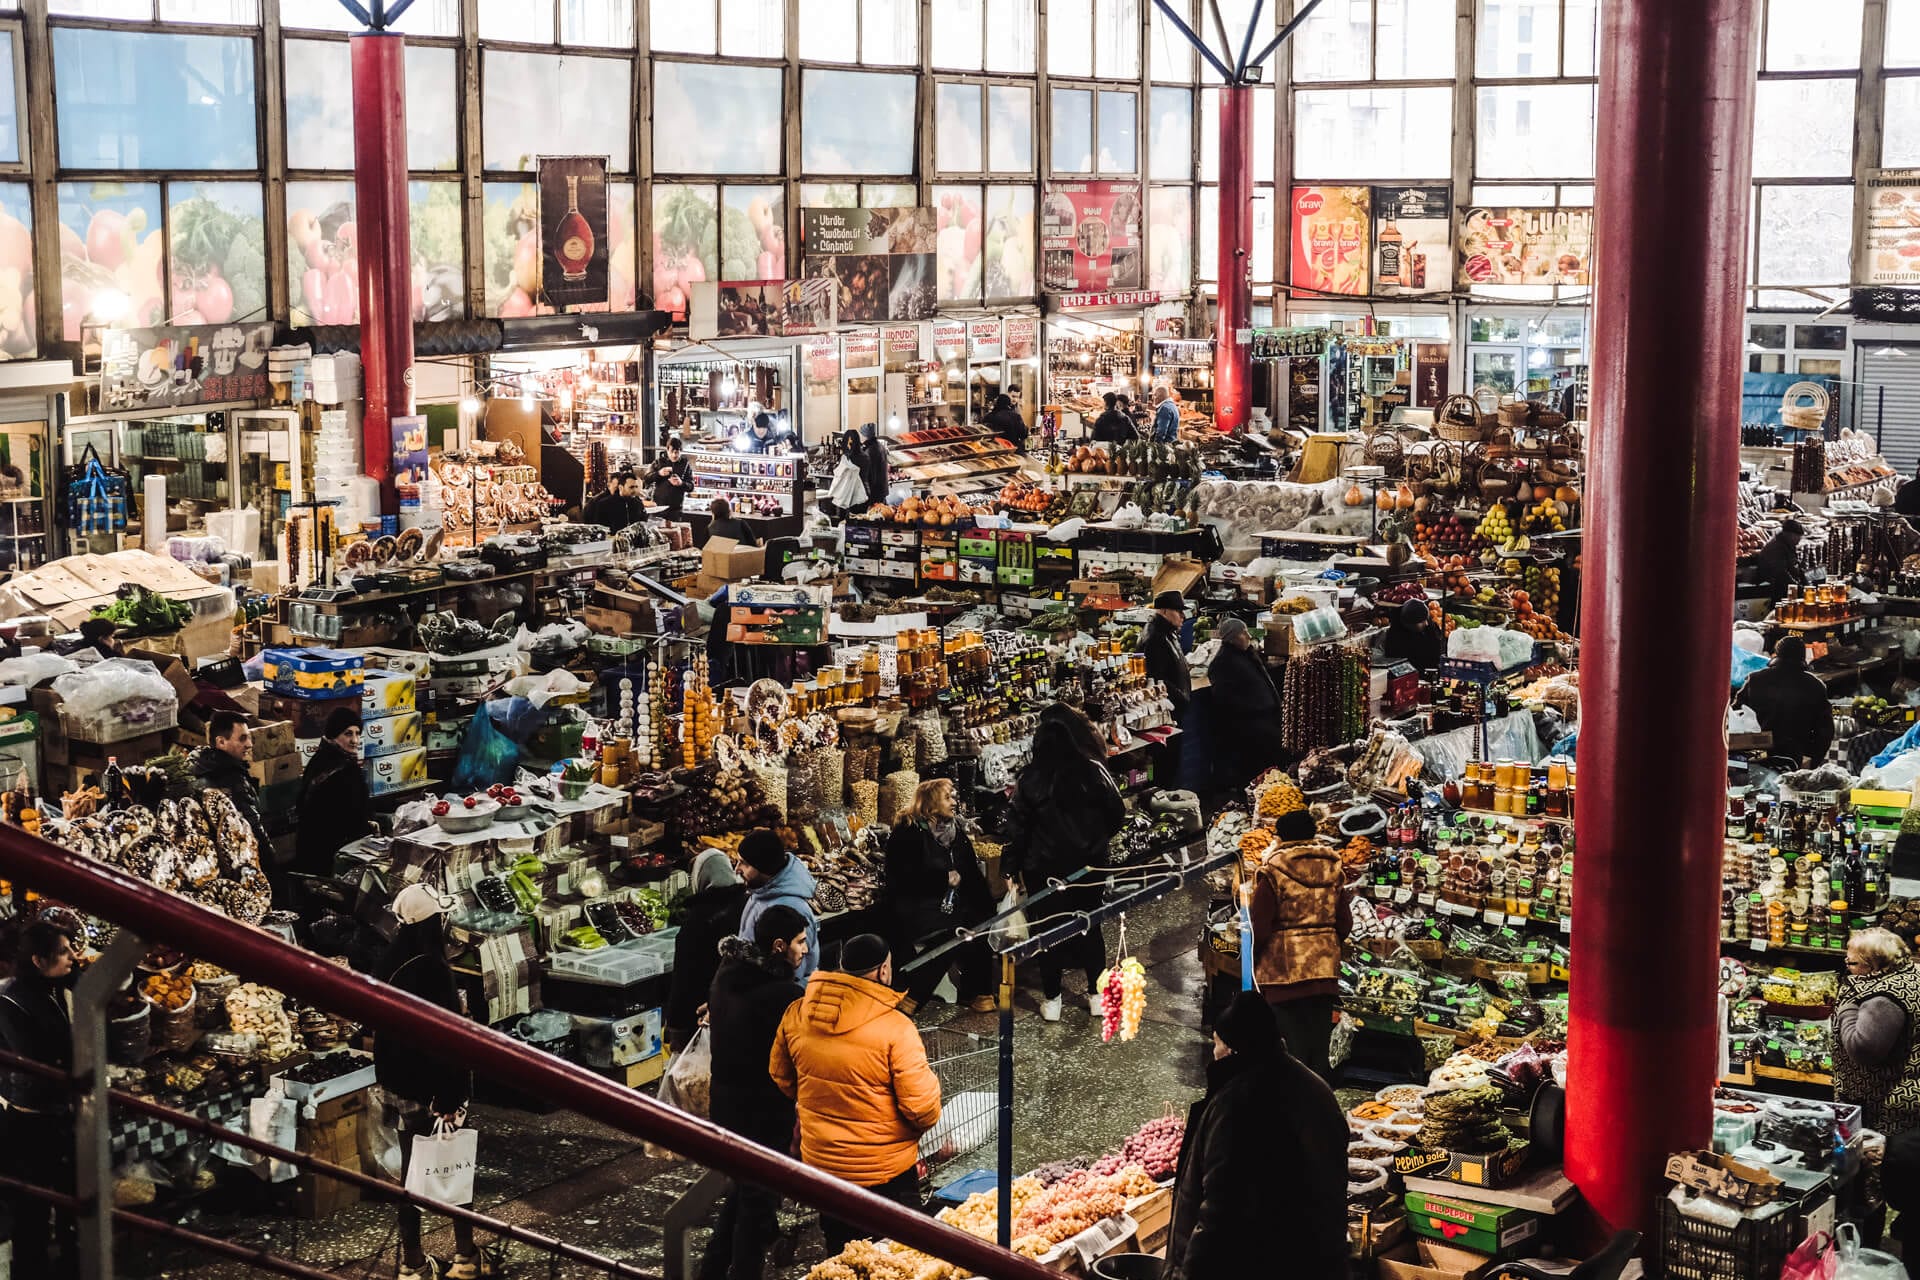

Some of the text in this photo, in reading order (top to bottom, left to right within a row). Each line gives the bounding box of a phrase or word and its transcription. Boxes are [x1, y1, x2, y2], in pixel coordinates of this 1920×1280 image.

[370, 725, 384, 734] Dole
[379, 762, 393, 771] Dole
[1426, 1151, 1446, 1162] gold
[1691, 1163, 1708, 1175] BLUE
[1424, 1201, 1443, 1214] BELL
[1444, 1207, 1475, 1223] PEPPER
